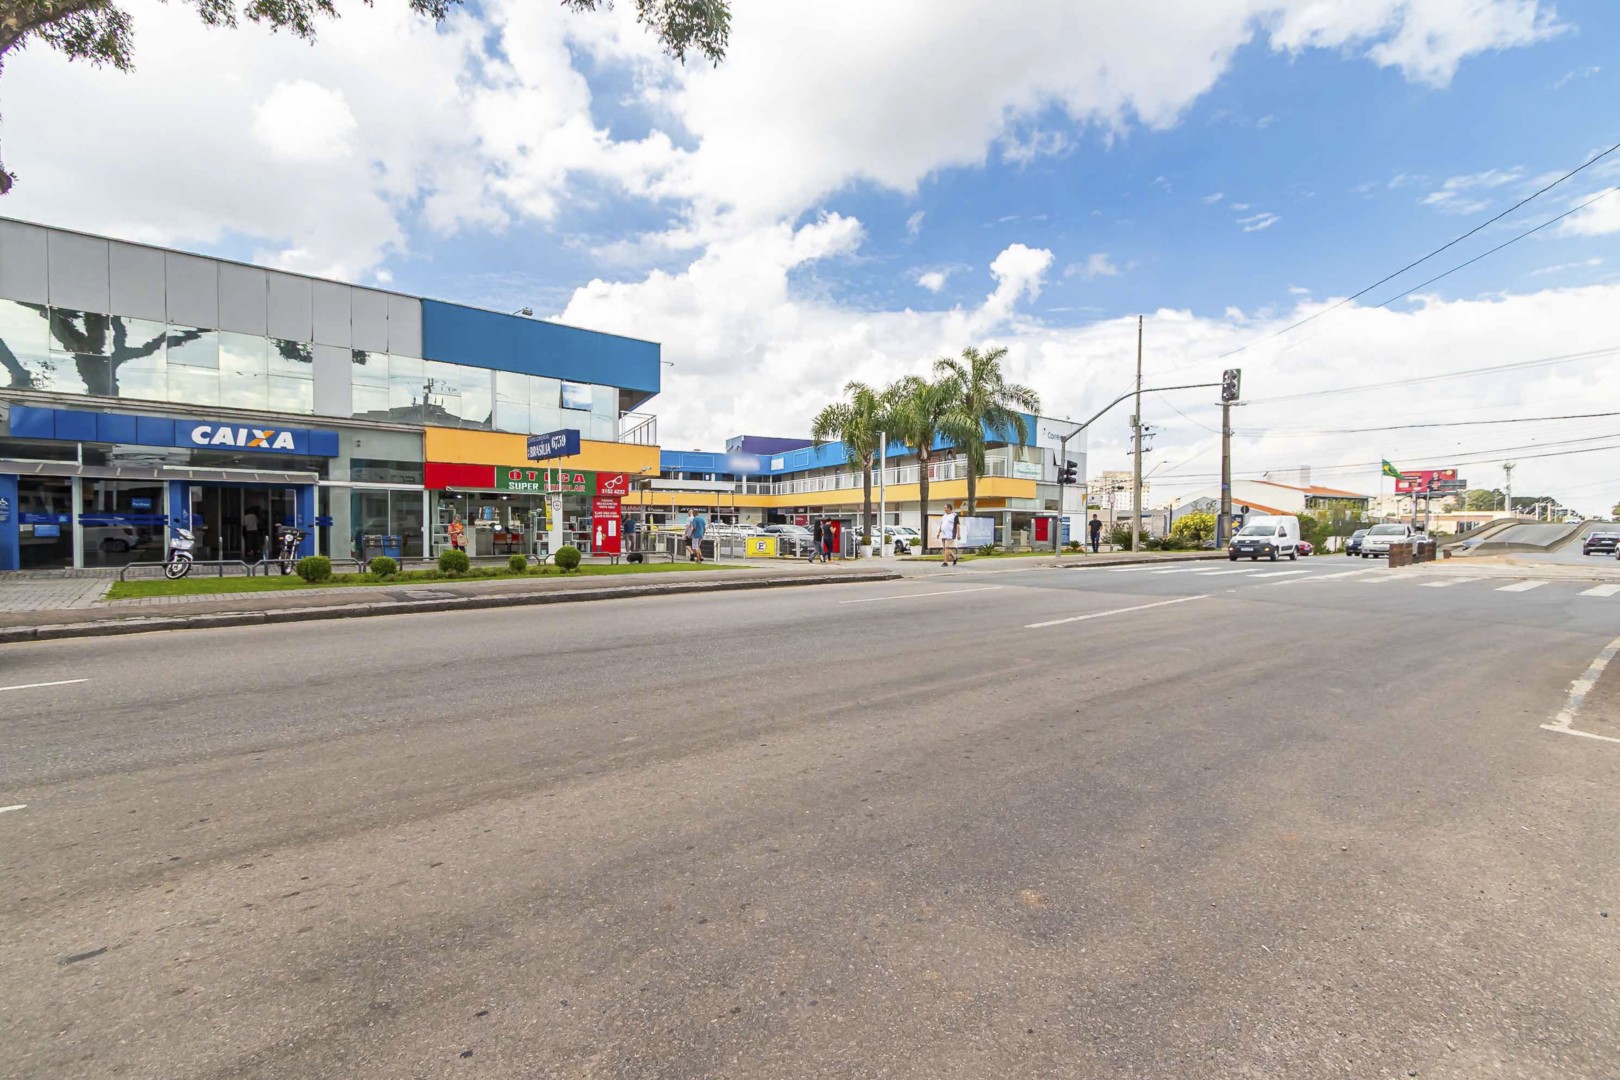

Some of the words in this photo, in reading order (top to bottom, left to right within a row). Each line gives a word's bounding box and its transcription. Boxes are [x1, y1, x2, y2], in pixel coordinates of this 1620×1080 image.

[191, 426, 295, 449] CAIXA
[551, 434, 566, 450] 6759
[530, 441, 551, 457] BRASÍLIA
[508, 468, 586, 483] ÓTICA
[508, 481, 539, 490] SUPER
